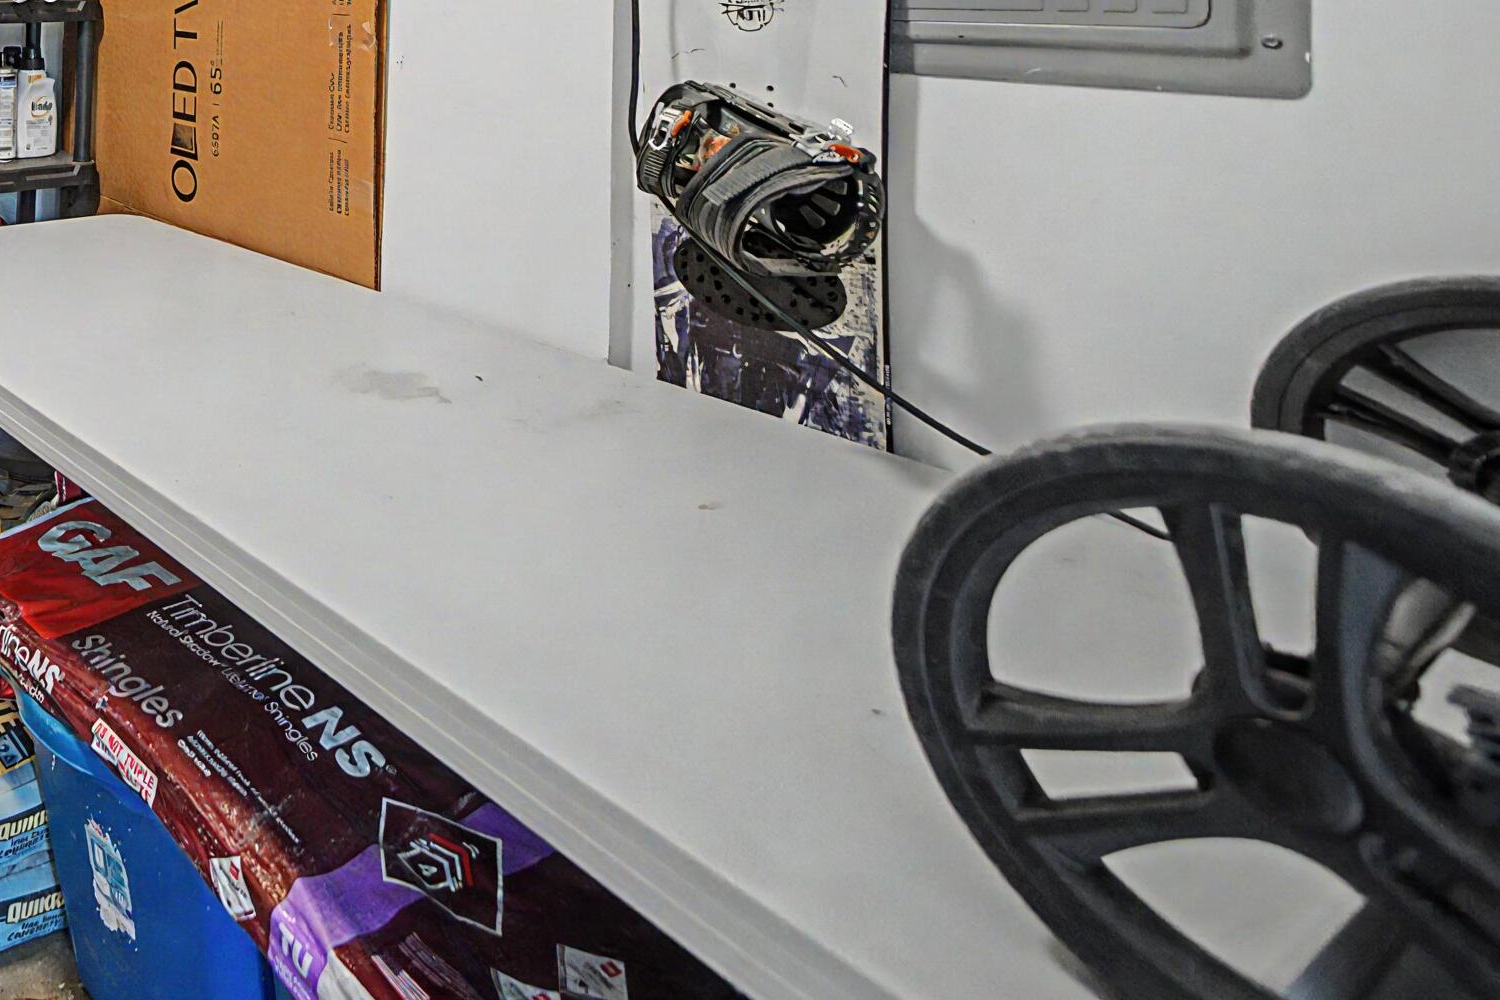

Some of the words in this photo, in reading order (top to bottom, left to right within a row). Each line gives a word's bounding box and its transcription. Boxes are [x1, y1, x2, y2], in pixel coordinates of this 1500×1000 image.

[170, 60, 199, 203] OLED
[37, 520, 182, 591] GAF
[71, 634, 184, 728] Shingles
[263, 699, 318, 762] Shingles
